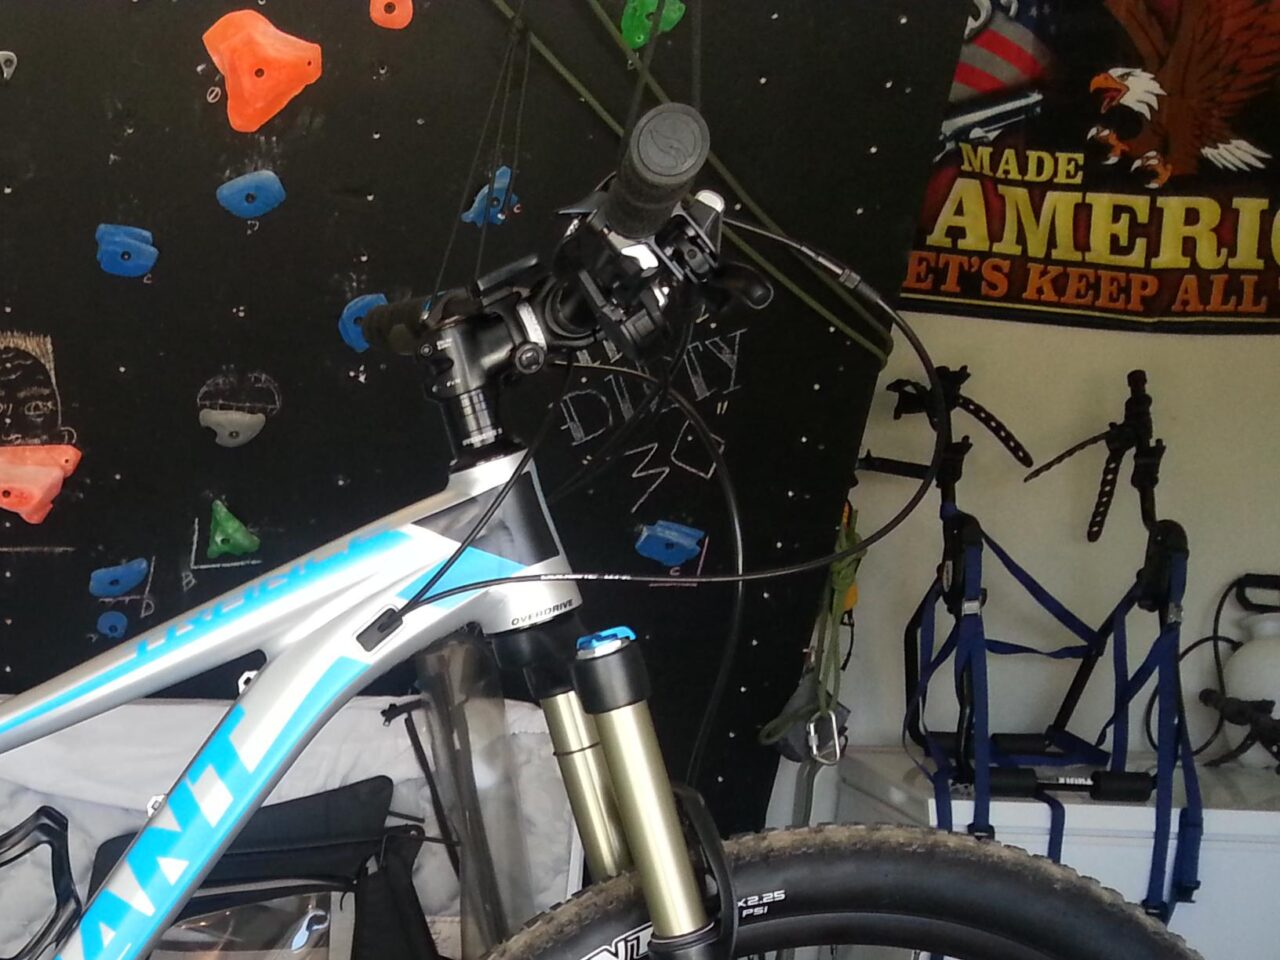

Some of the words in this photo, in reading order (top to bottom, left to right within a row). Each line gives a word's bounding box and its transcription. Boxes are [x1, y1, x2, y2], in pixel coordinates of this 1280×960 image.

[960, 141, 1085, 186] MADE
[926, 177, 1280, 271] AMERI
[1022, 262, 1160, 313] KEEP
[1171, 275, 1269, 314] ALL
[742, 905, 769, 918] PSI
